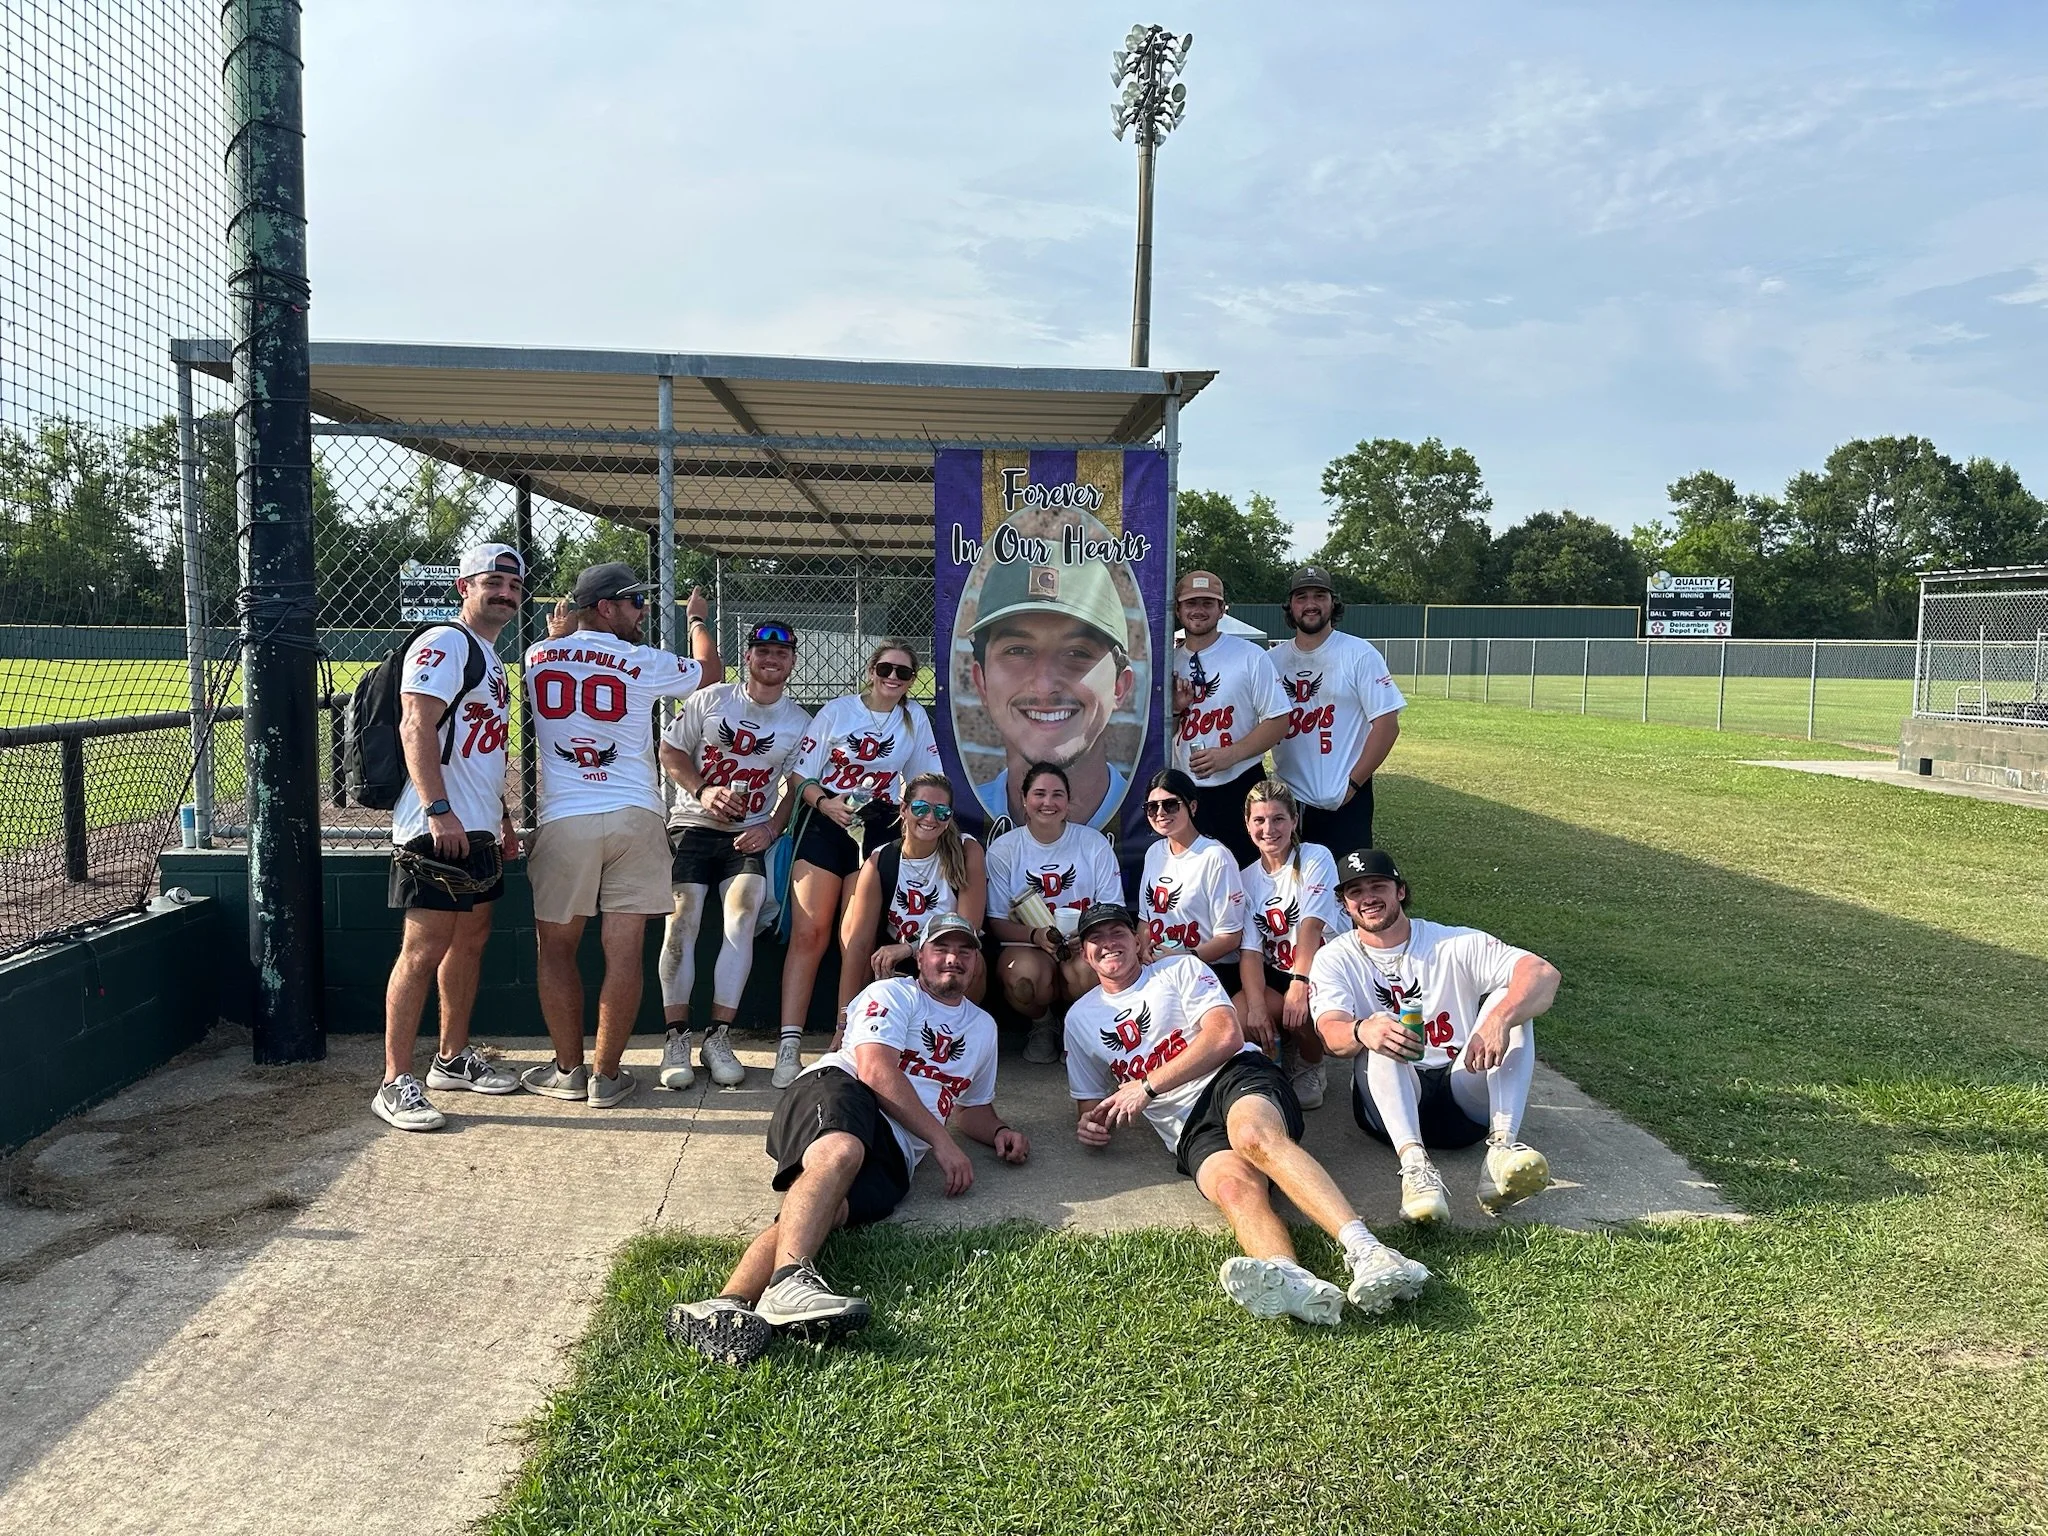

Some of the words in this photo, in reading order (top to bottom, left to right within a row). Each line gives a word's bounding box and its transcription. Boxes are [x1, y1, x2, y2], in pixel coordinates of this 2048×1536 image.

[1002, 468, 1104, 511] Forever
[952, 523, 982, 565] In
[993, 523, 1051, 564] Our
[1063, 523, 1151, 565] Hearts
[1675, 578, 1714, 586] QUALITY
[1719, 578, 1731, 591] 2
[416, 648, 446, 668] 27
[534, 669, 628, 722] 00
[462, 702, 494, 721] The
[1284, 704, 1335, 739] 8ers
[801, 736, 817, 753] 27
[1320, 732, 1332, 754] 5
